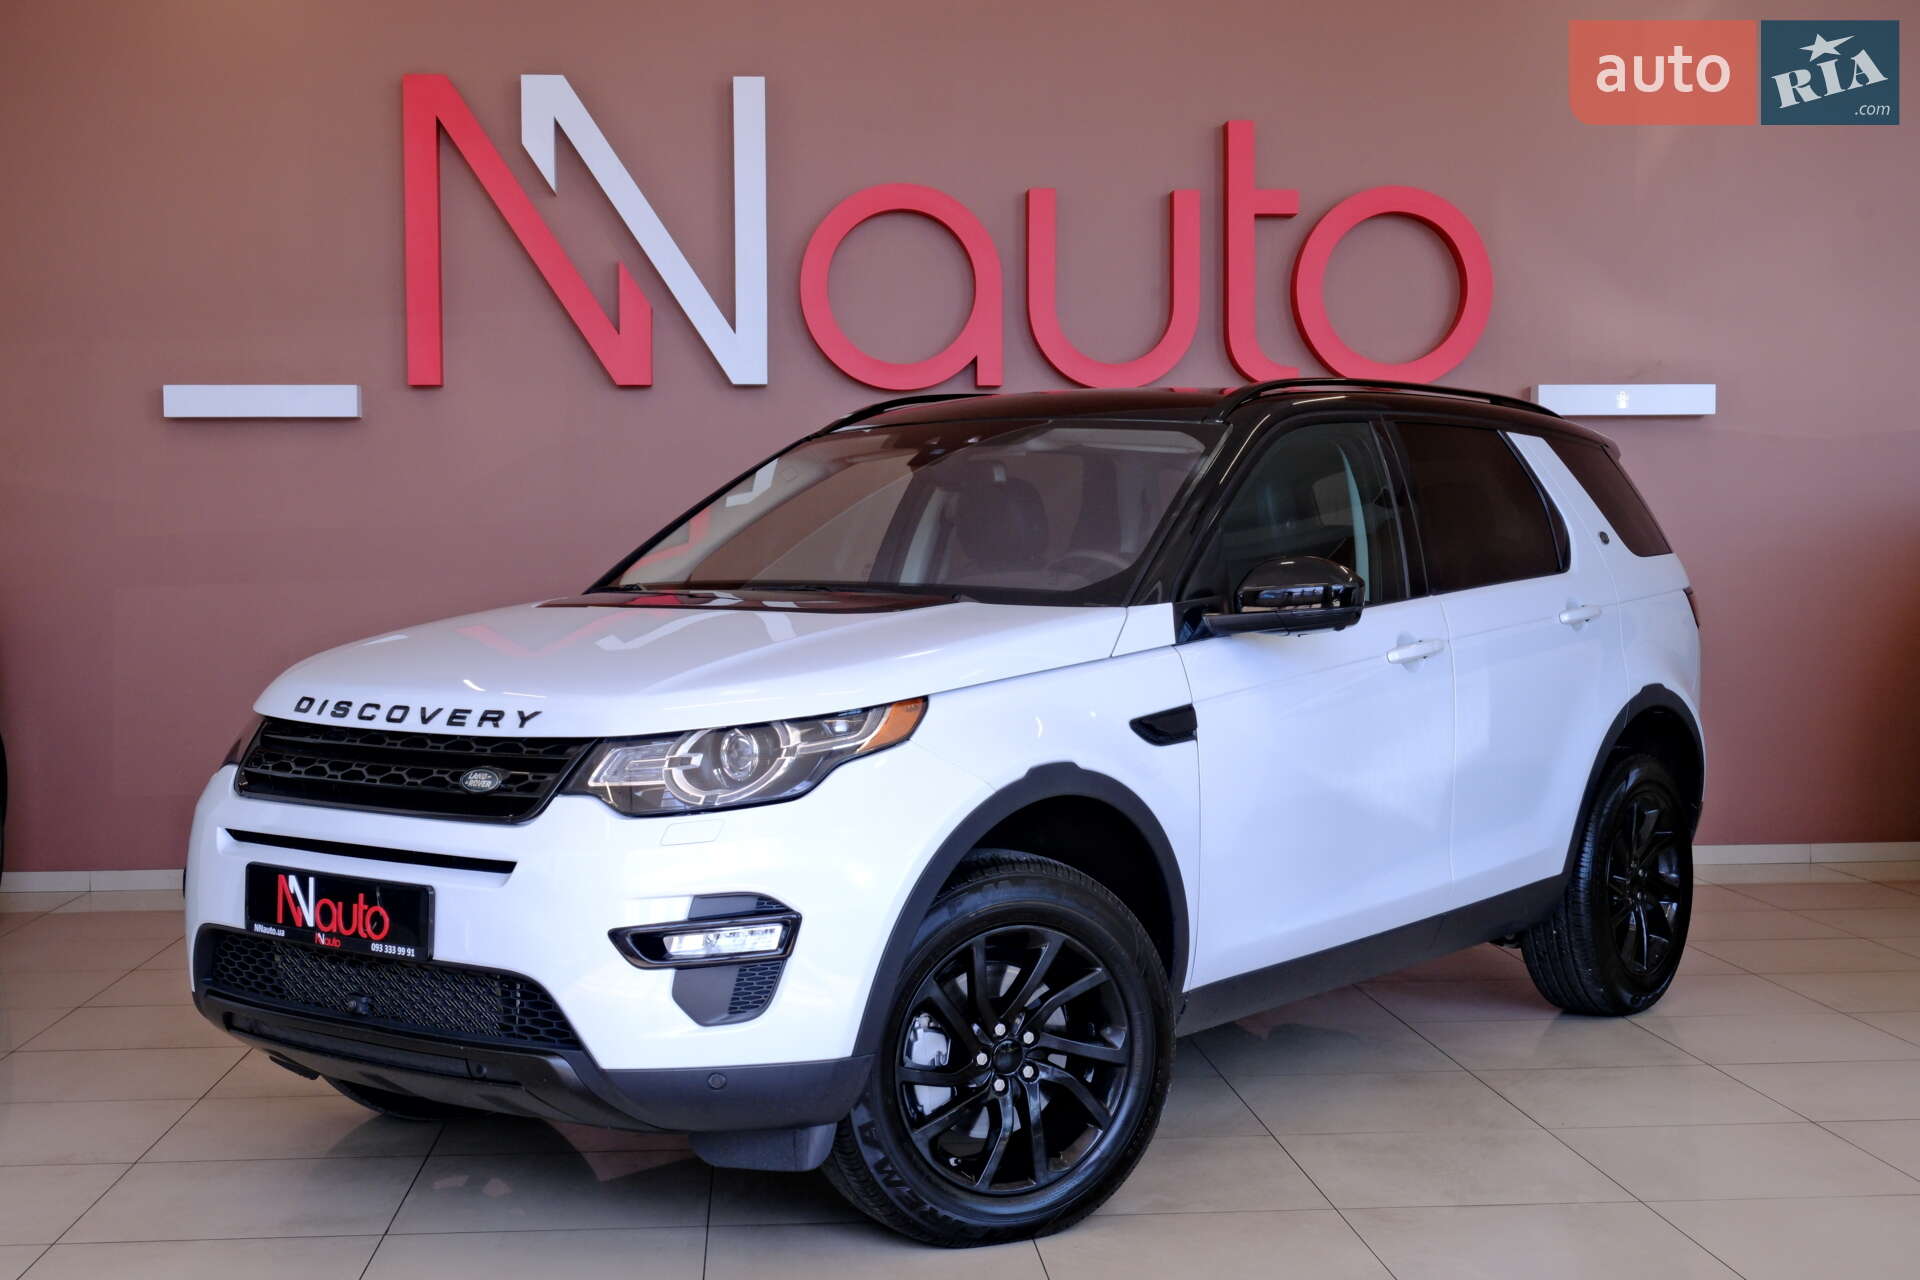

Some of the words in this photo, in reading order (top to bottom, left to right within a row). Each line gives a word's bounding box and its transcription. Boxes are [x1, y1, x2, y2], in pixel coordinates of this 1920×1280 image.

[294, 696, 543, 728] DISCOVERY
[371, 942, 383, 952] 093
[384, 944, 396, 954] 333
[397, 946, 405, 956] 99
[406, 948, 415, 957] 91
